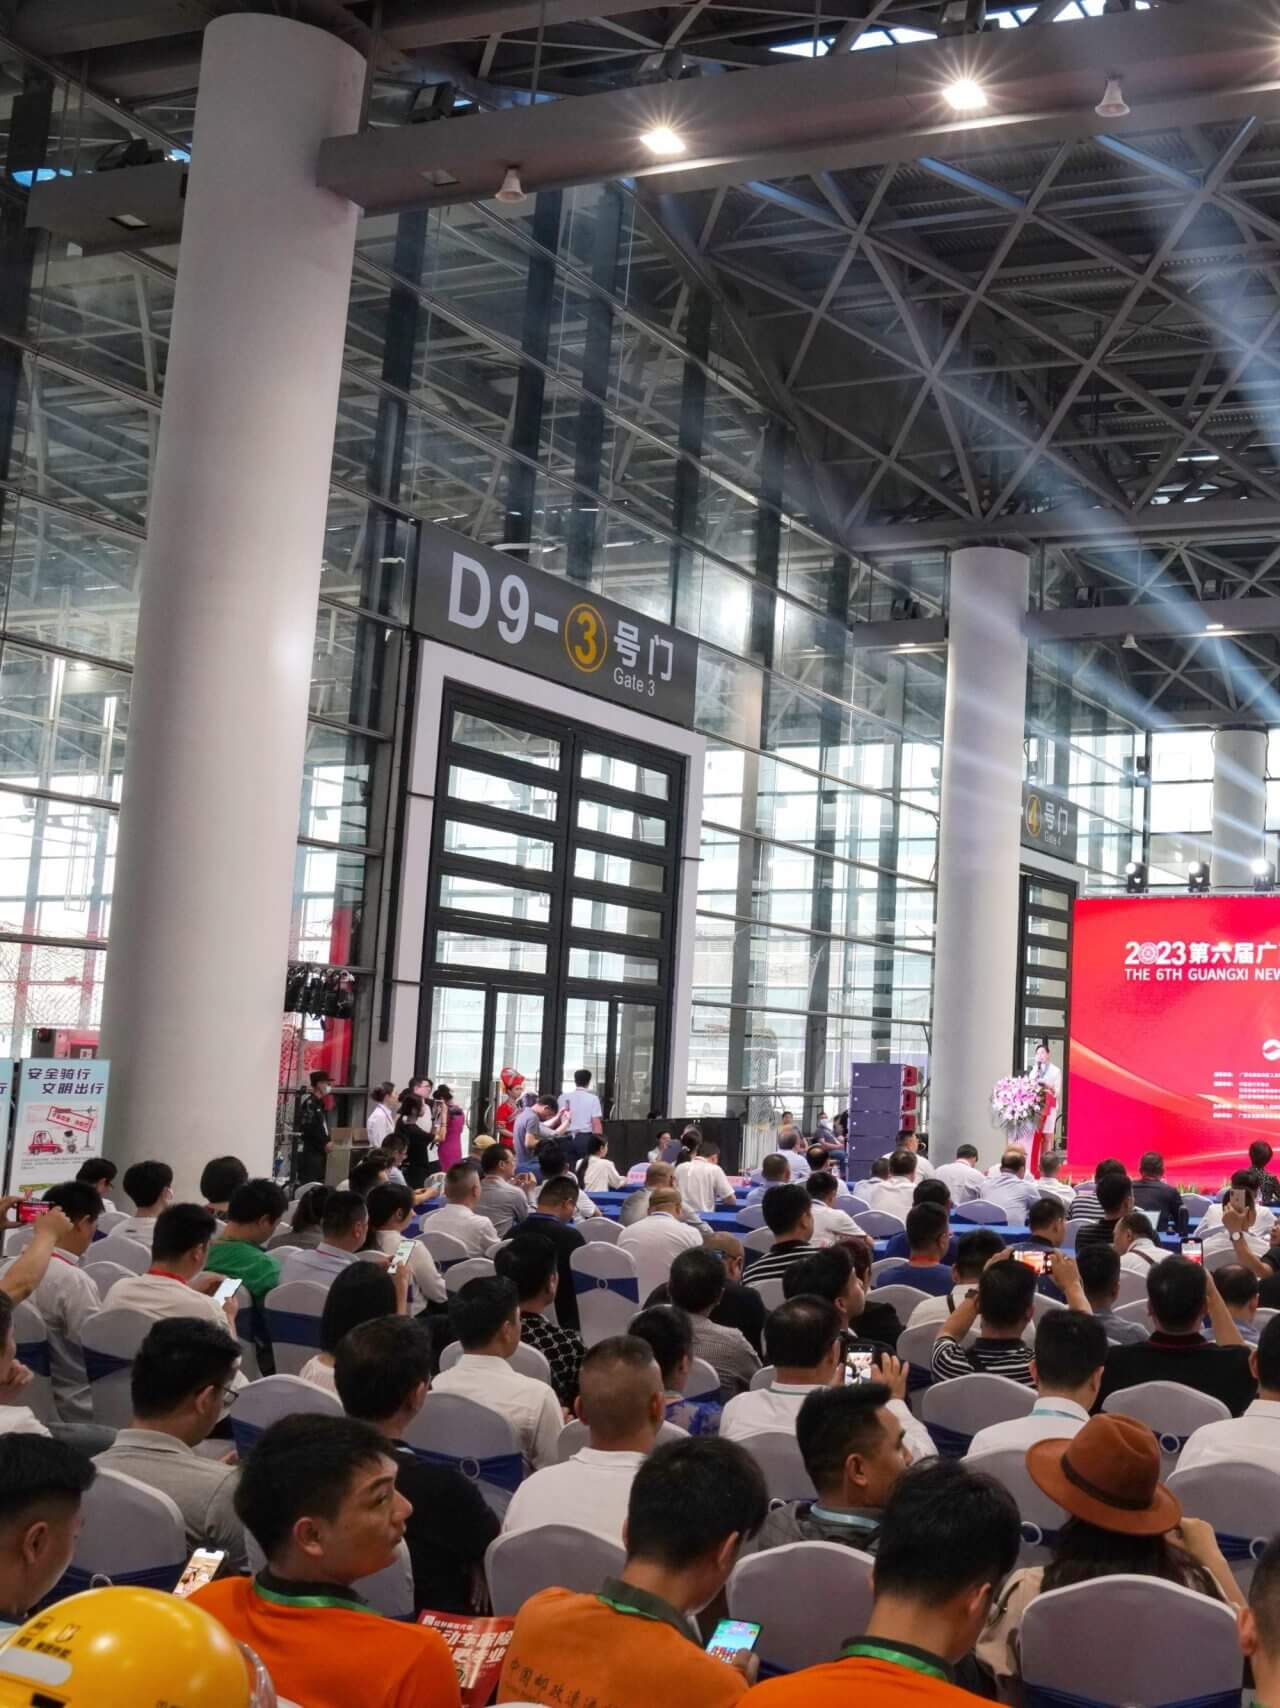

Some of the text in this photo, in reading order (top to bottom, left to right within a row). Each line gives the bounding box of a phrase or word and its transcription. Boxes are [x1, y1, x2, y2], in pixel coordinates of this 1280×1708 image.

[614, 667, 656, 697] Gate 3
[1124, 968, 1150, 981] THE
[1155, 968, 1182, 981] 6TH
[1187, 968, 1248, 981] GUANGXI
[28, 1067, 91, 1081] 安全骑行
[42, 1082, 105, 1095] 文明出行
[433, 1628, 514, 1648] 动车保险
